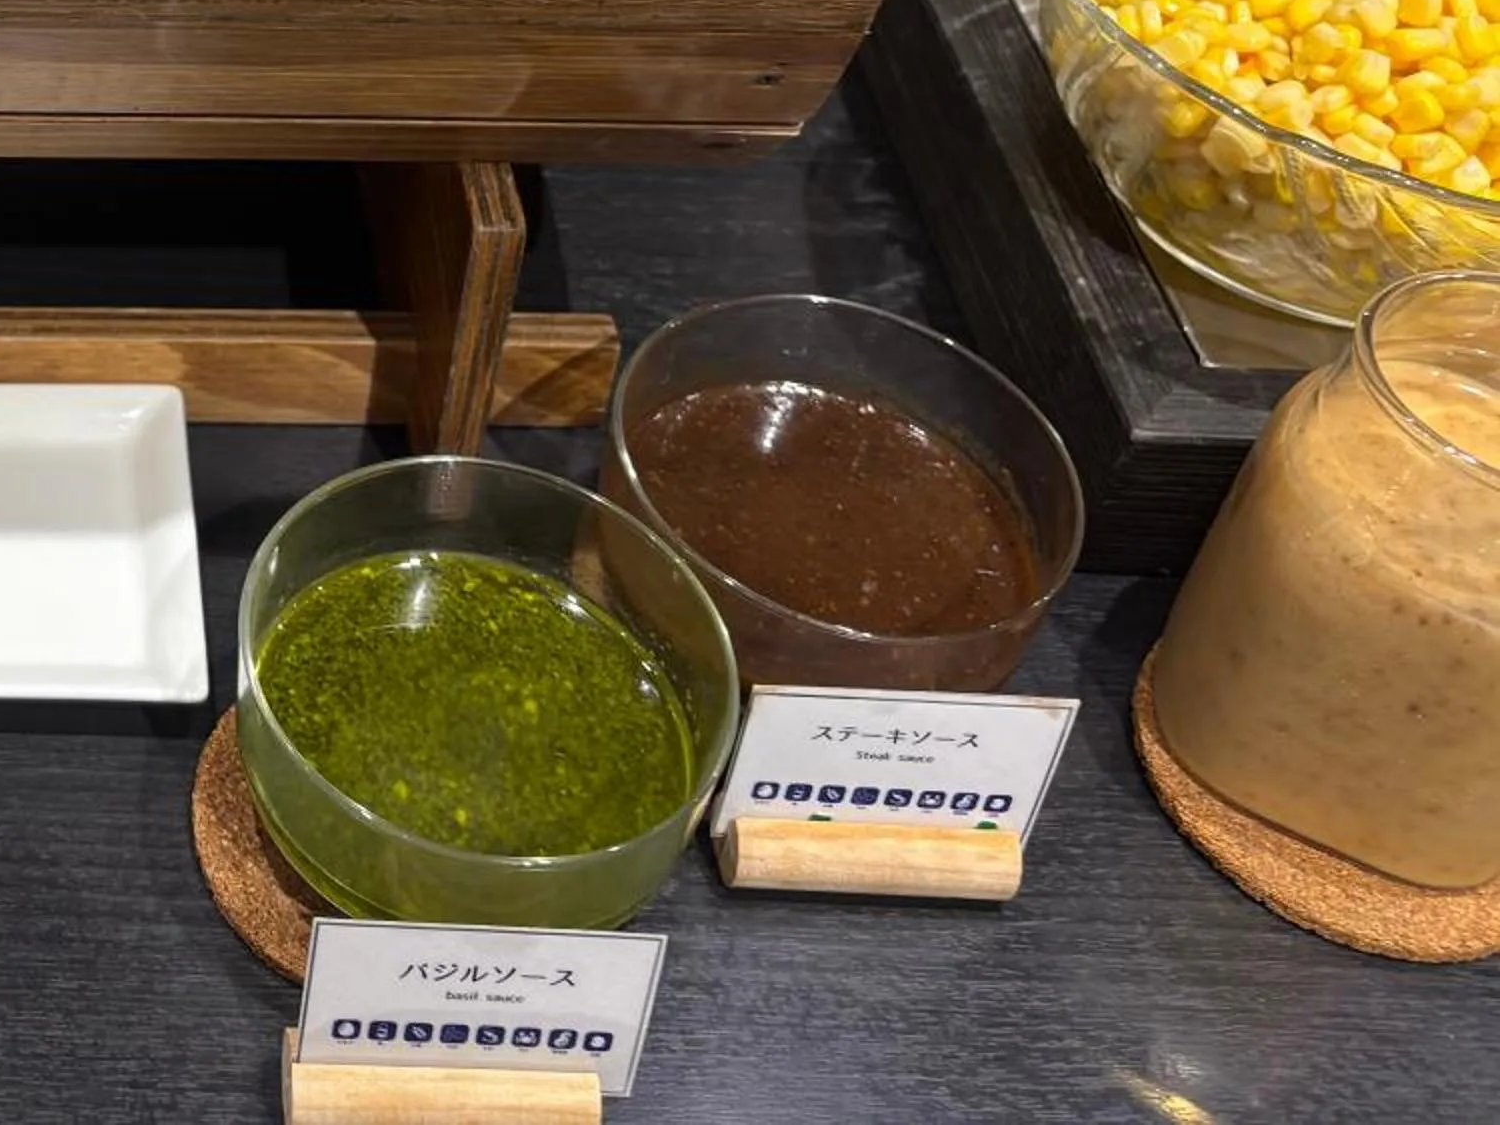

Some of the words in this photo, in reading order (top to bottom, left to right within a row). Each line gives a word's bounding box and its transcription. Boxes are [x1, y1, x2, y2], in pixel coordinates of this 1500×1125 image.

[811, 726, 979, 748] ステーキソース
[856, 750, 889, 761] Steak
[899, 754, 935, 764] sauce
[398, 962, 576, 987] バジルソース
[445, 991, 479, 1001] basil
[485, 994, 526, 1004] sauce
